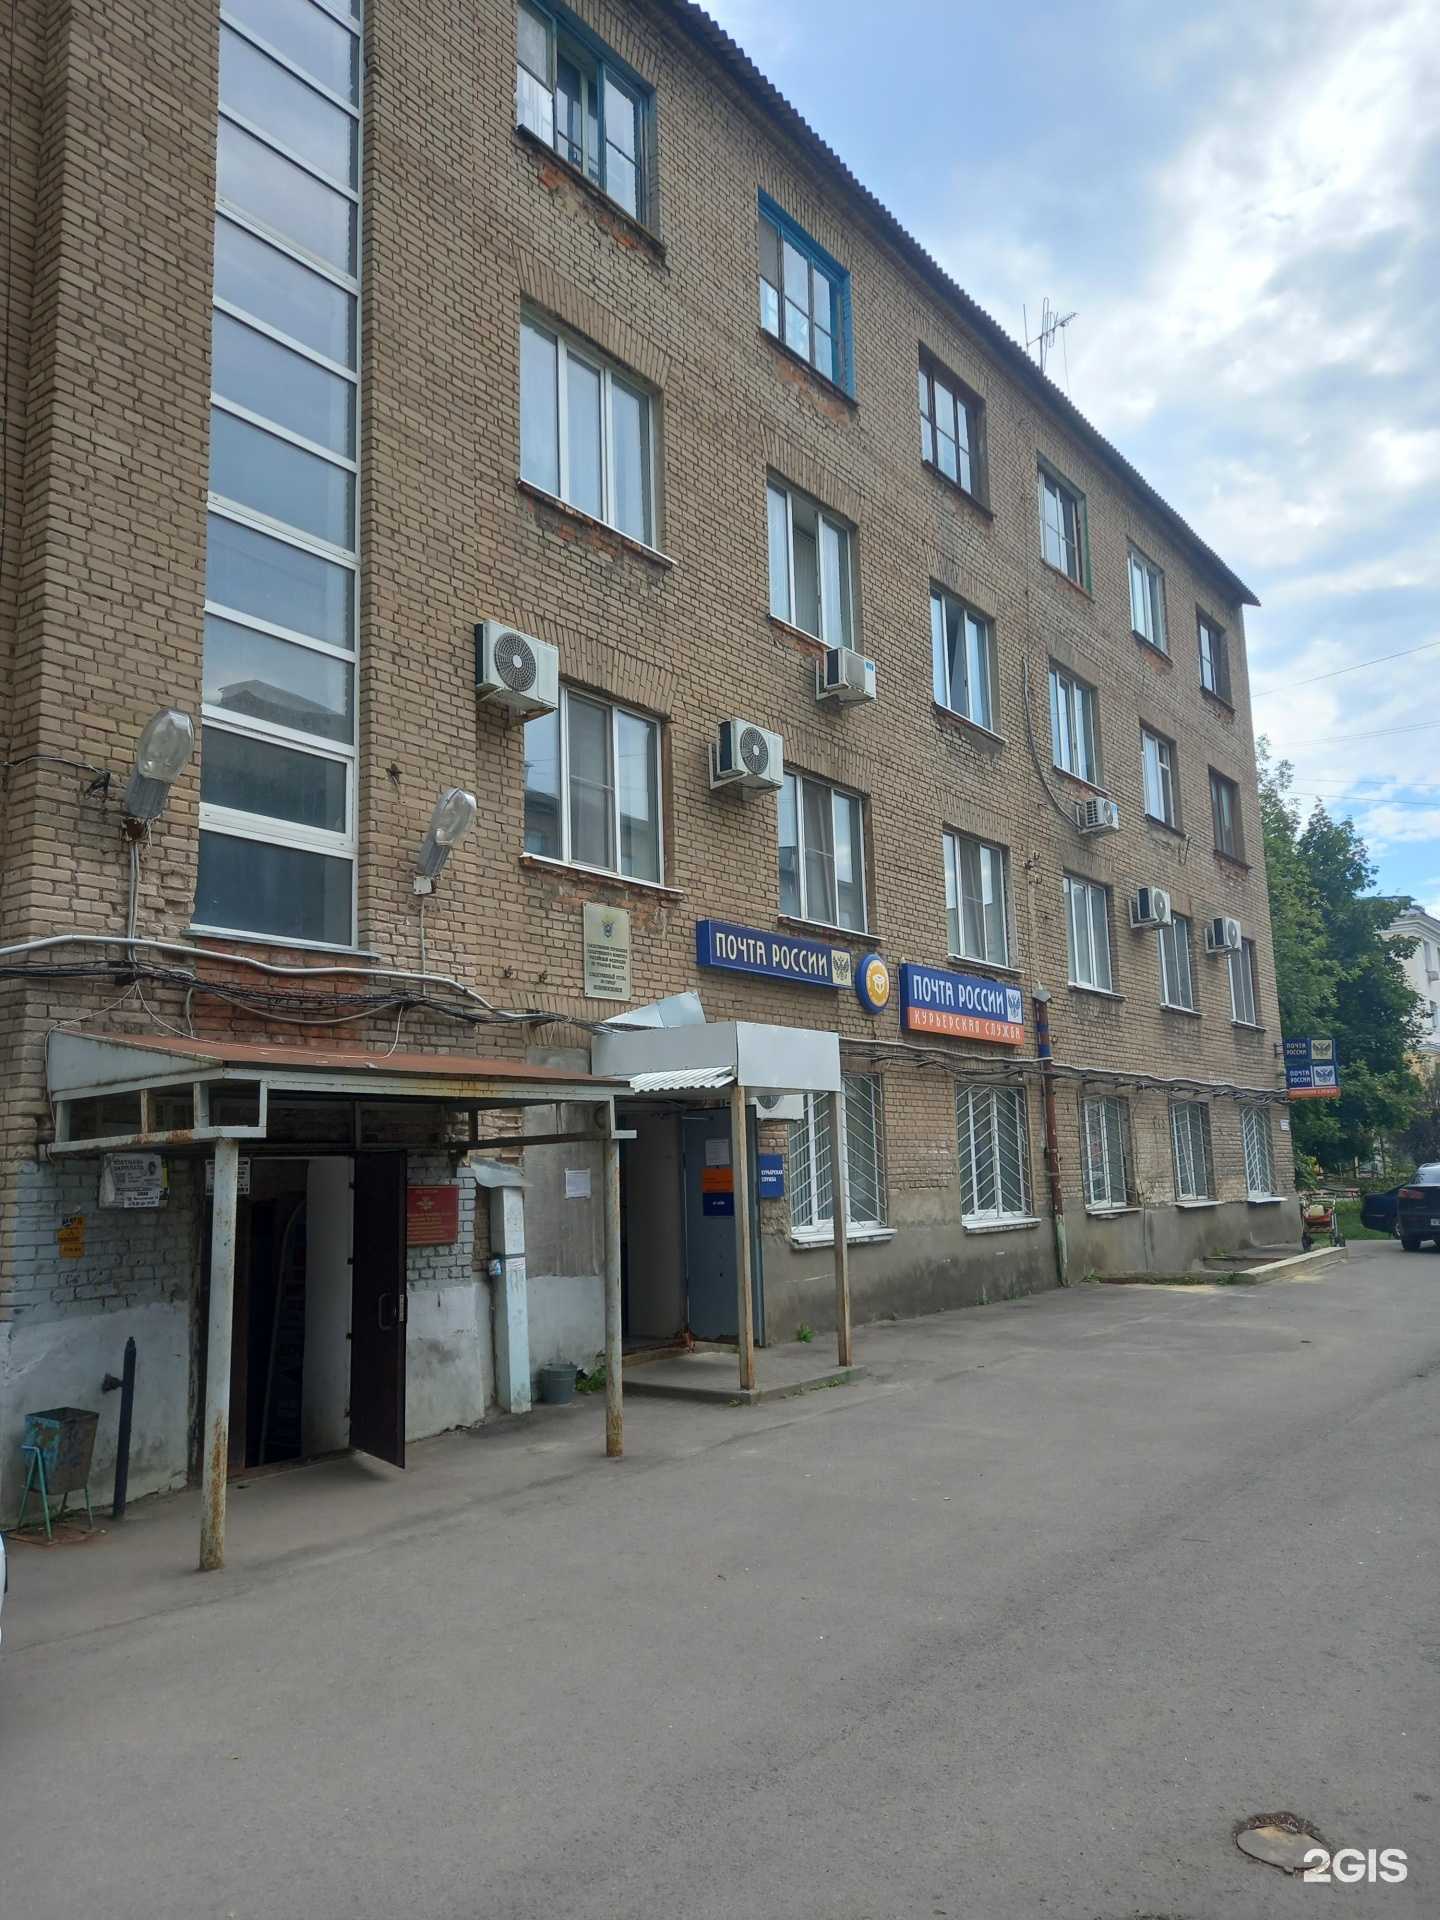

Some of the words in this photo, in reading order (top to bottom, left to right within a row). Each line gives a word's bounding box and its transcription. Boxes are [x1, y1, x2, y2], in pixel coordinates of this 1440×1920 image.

[715, 932, 767, 966] ПОЧТА
[772, 943, 828, 977] РОССИИ
[913, 974, 955, 1007] ПОЧТА
[958, 983, 1005, 1015] РОССИИ
[985, 1022, 1021, 1040] СЛУЖБА
